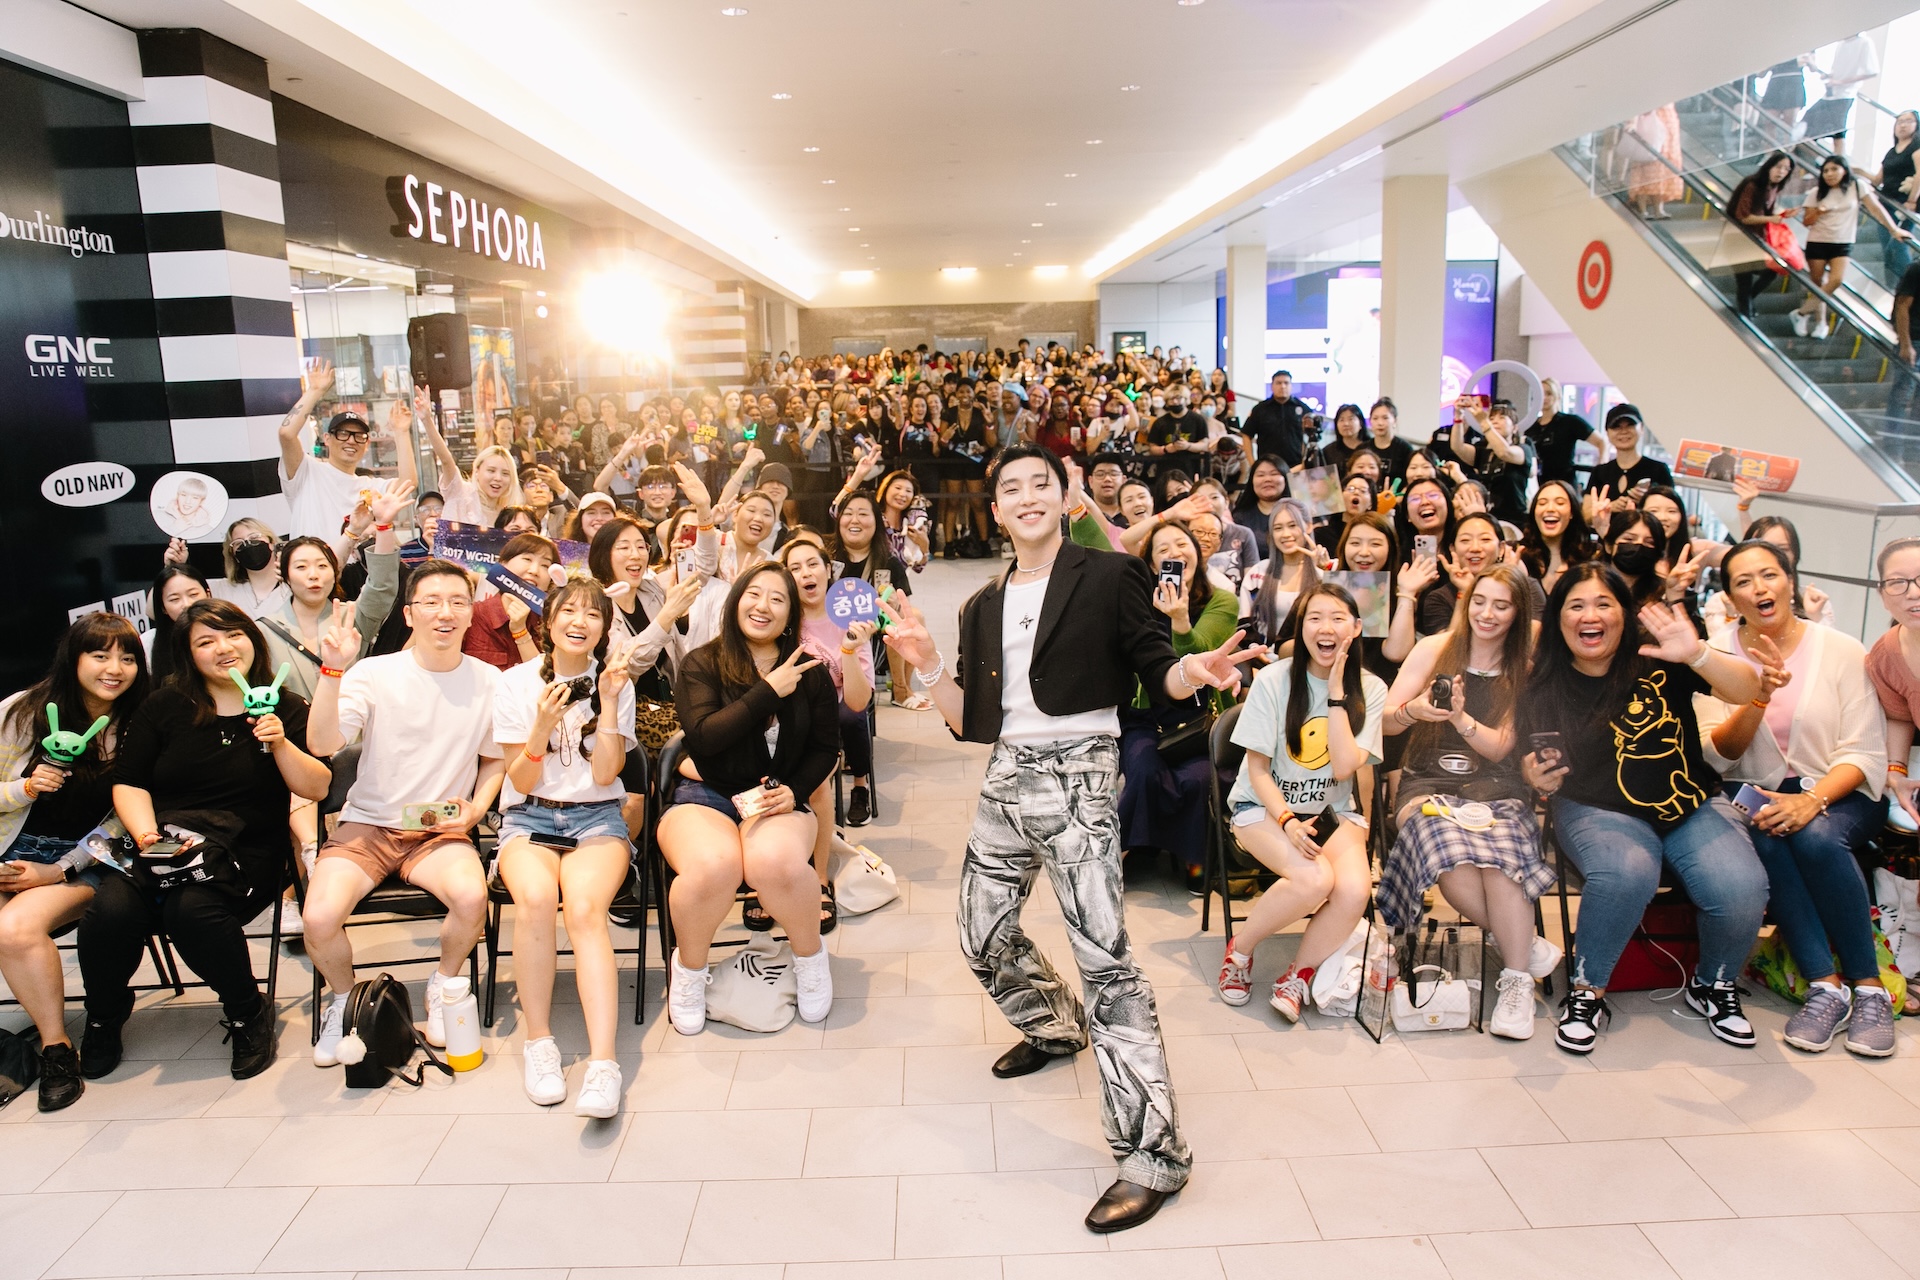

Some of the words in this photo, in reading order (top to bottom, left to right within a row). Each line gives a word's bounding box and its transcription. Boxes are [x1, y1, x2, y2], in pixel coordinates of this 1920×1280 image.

[404, 174, 546, 270] SEPHORA
[25, 334, 114, 363] GNC
[29, 365, 66, 377] LIVE
[75, 365, 115, 377] WELL
[54, 478, 84, 497] OLD
[87, 472, 124, 492] NAVY
[442, 546, 464, 559] 2017
[117, 598, 142, 618] UNI
[833, 592, 873, 617] 종업
[1272, 769, 1339, 791] EVERYTHIN
[1284, 791, 1325, 804] SUCKS
